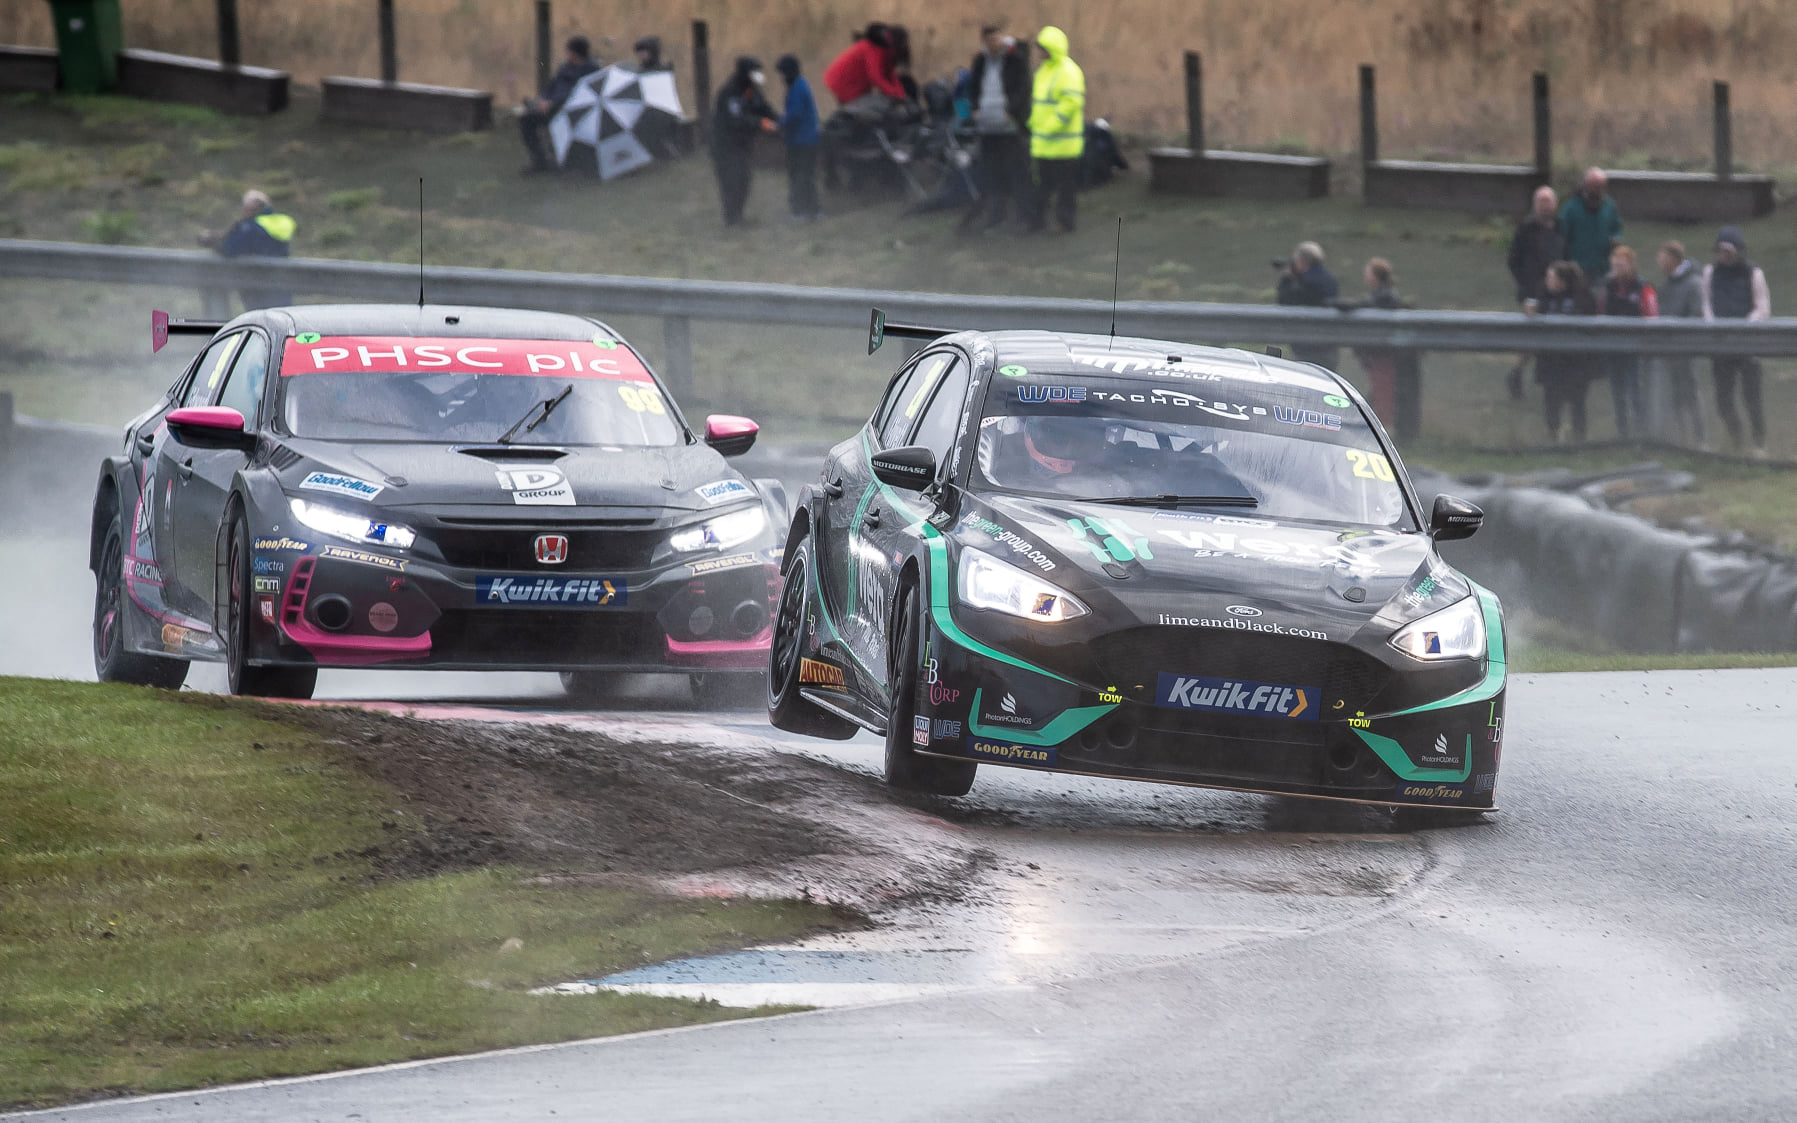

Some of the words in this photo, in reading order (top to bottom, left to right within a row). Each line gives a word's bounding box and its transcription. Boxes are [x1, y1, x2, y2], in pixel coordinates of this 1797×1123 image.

[311, 345, 503, 368] PHSC
[526, 351, 621, 375] plc
[1018, 385, 1086, 403] WDE
[1273, 405, 1341, 428] WDE
[873, 459, 927, 475] MOTORBASE
[1345, 449, 1395, 483] 20
[519, 490, 566, 498] GROUP
[255, 537, 308, 551] GOODYEAR
[253, 558, 284, 573] Spectra
[330, 549, 397, 567] RAVENOL
[1159, 613, 1328, 641] limeandblack.com
[1098, 692, 1123, 704] TOW
[933, 718, 962, 740] WDE
[1348, 718, 1371, 728] TOW
[974, 742, 1048, 761] GOODYEAR
[1403, 785, 1463, 799] GOODYEAR
